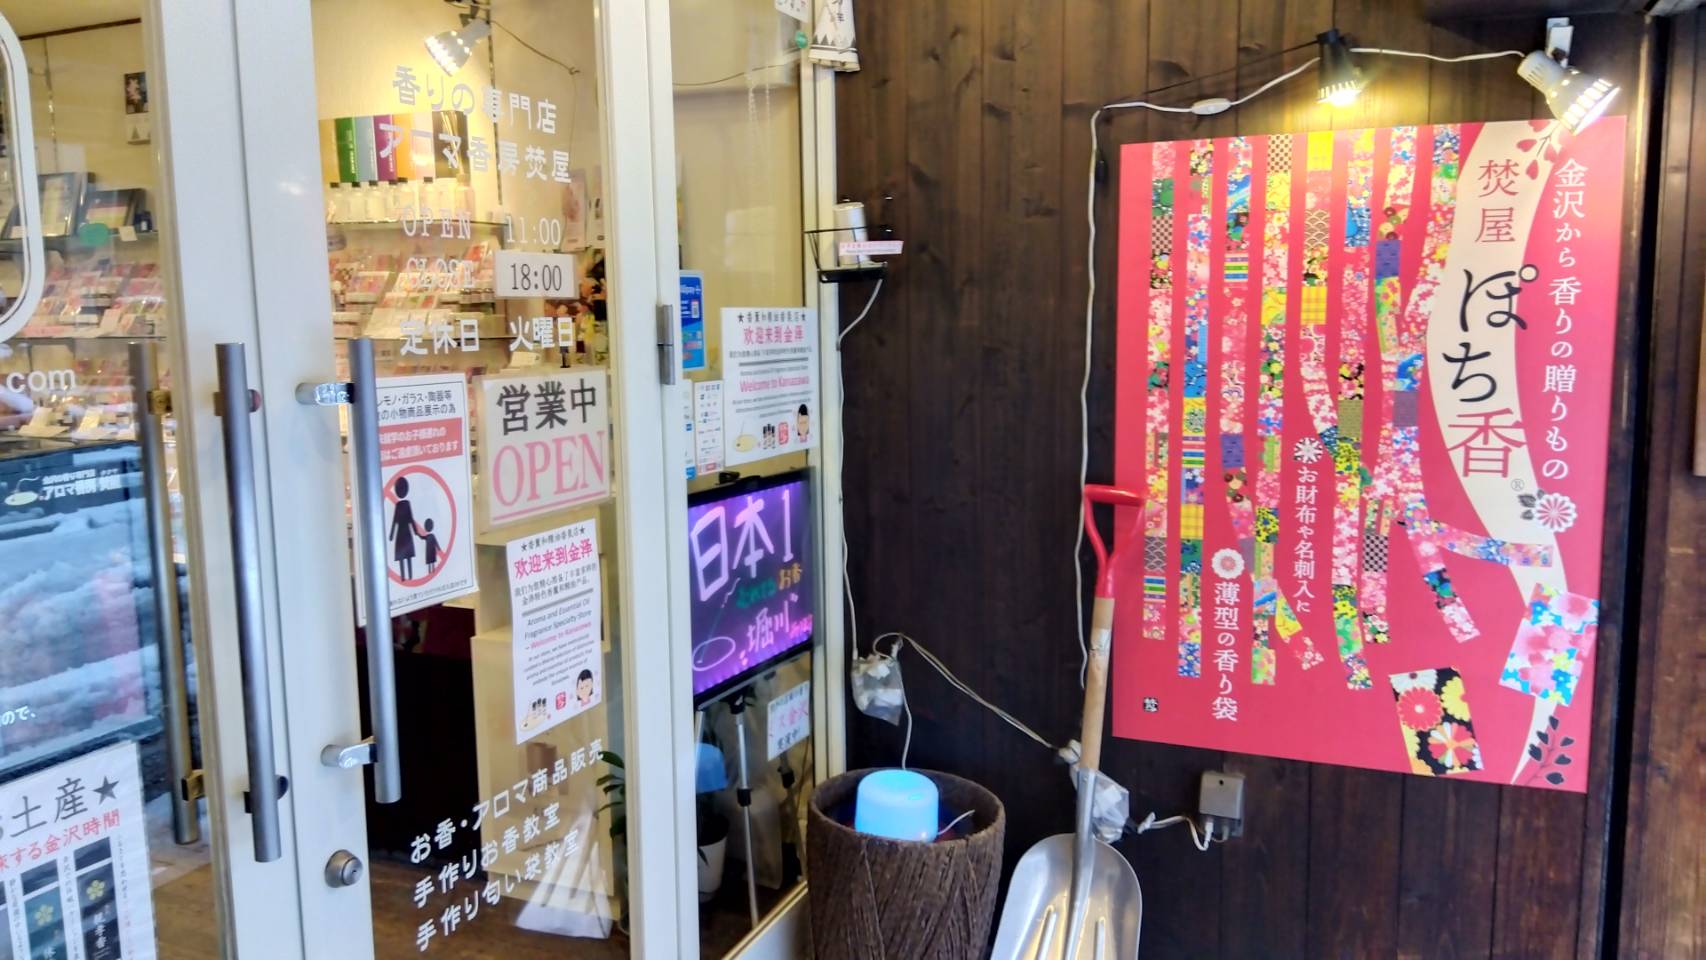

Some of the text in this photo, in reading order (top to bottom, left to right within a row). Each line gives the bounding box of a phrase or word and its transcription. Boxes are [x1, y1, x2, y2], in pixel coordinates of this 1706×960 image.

[392, 65, 557, 134] 香りの専門店
[402, 211, 561, 246] OPEN 11:00
[1475, 158, 1520, 244] 焚屋
[511, 263, 562, 291] 18:00
[1541, 157, 1589, 480] 金沢から香りの贈りもの
[400, 316, 575, 356] 定休日 火曜日
[1441, 263, 1540, 478] ぽち香
[497, 378, 597, 436] 営業中
[492, 430, 606, 507] OPEN
[514, 538, 593, 580] 欢迎来到金泽
[1293, 466, 1319, 614] お財布や名刺入に
[1211, 581, 1241, 722] 薄型の香り袋
[410, 739, 604, 864] お香・アロマ商品販売
[413, 803, 560, 909] 手作りお香教室
[416, 829, 579, 952] 手作り匂い袋教室
